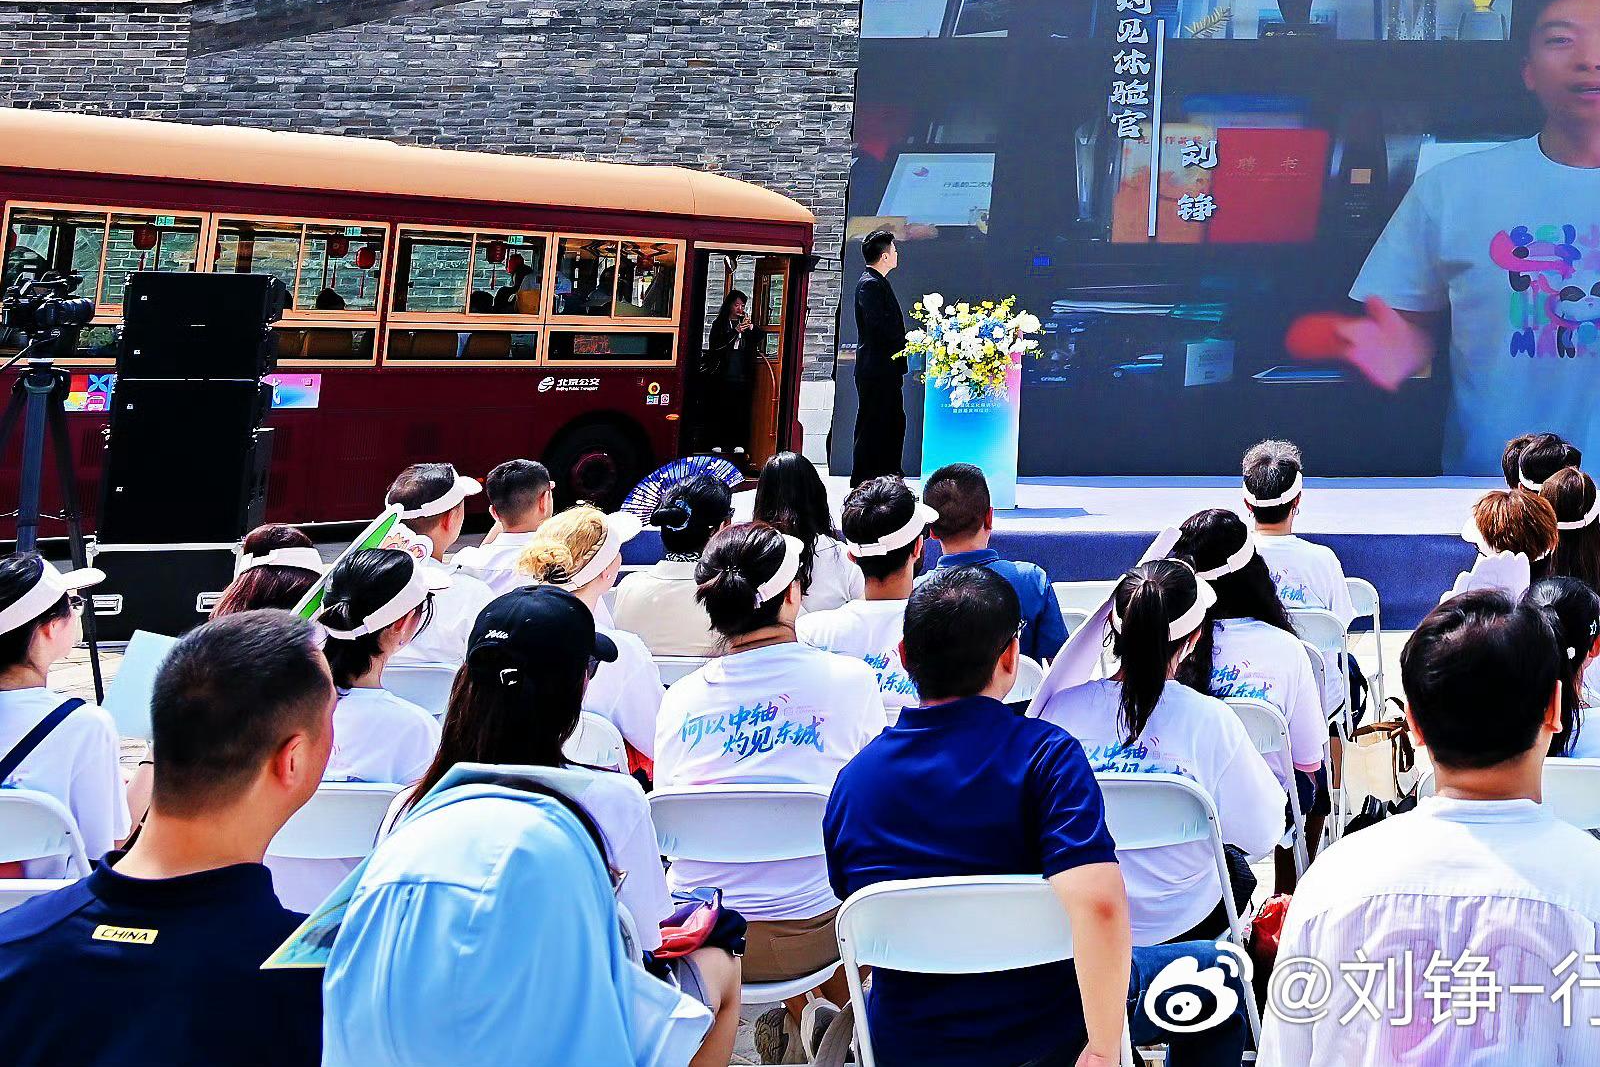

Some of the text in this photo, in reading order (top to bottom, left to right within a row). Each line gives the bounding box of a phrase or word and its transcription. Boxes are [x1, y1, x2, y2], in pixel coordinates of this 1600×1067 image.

[1177, 140, 1218, 222] 刘铮
[557, 378, 600, 386] 北京公交
[678, 700, 779, 753] 何以中轴
[722, 715, 825, 764] 灼见东城
[101, 928, 148, 941] CHINA
